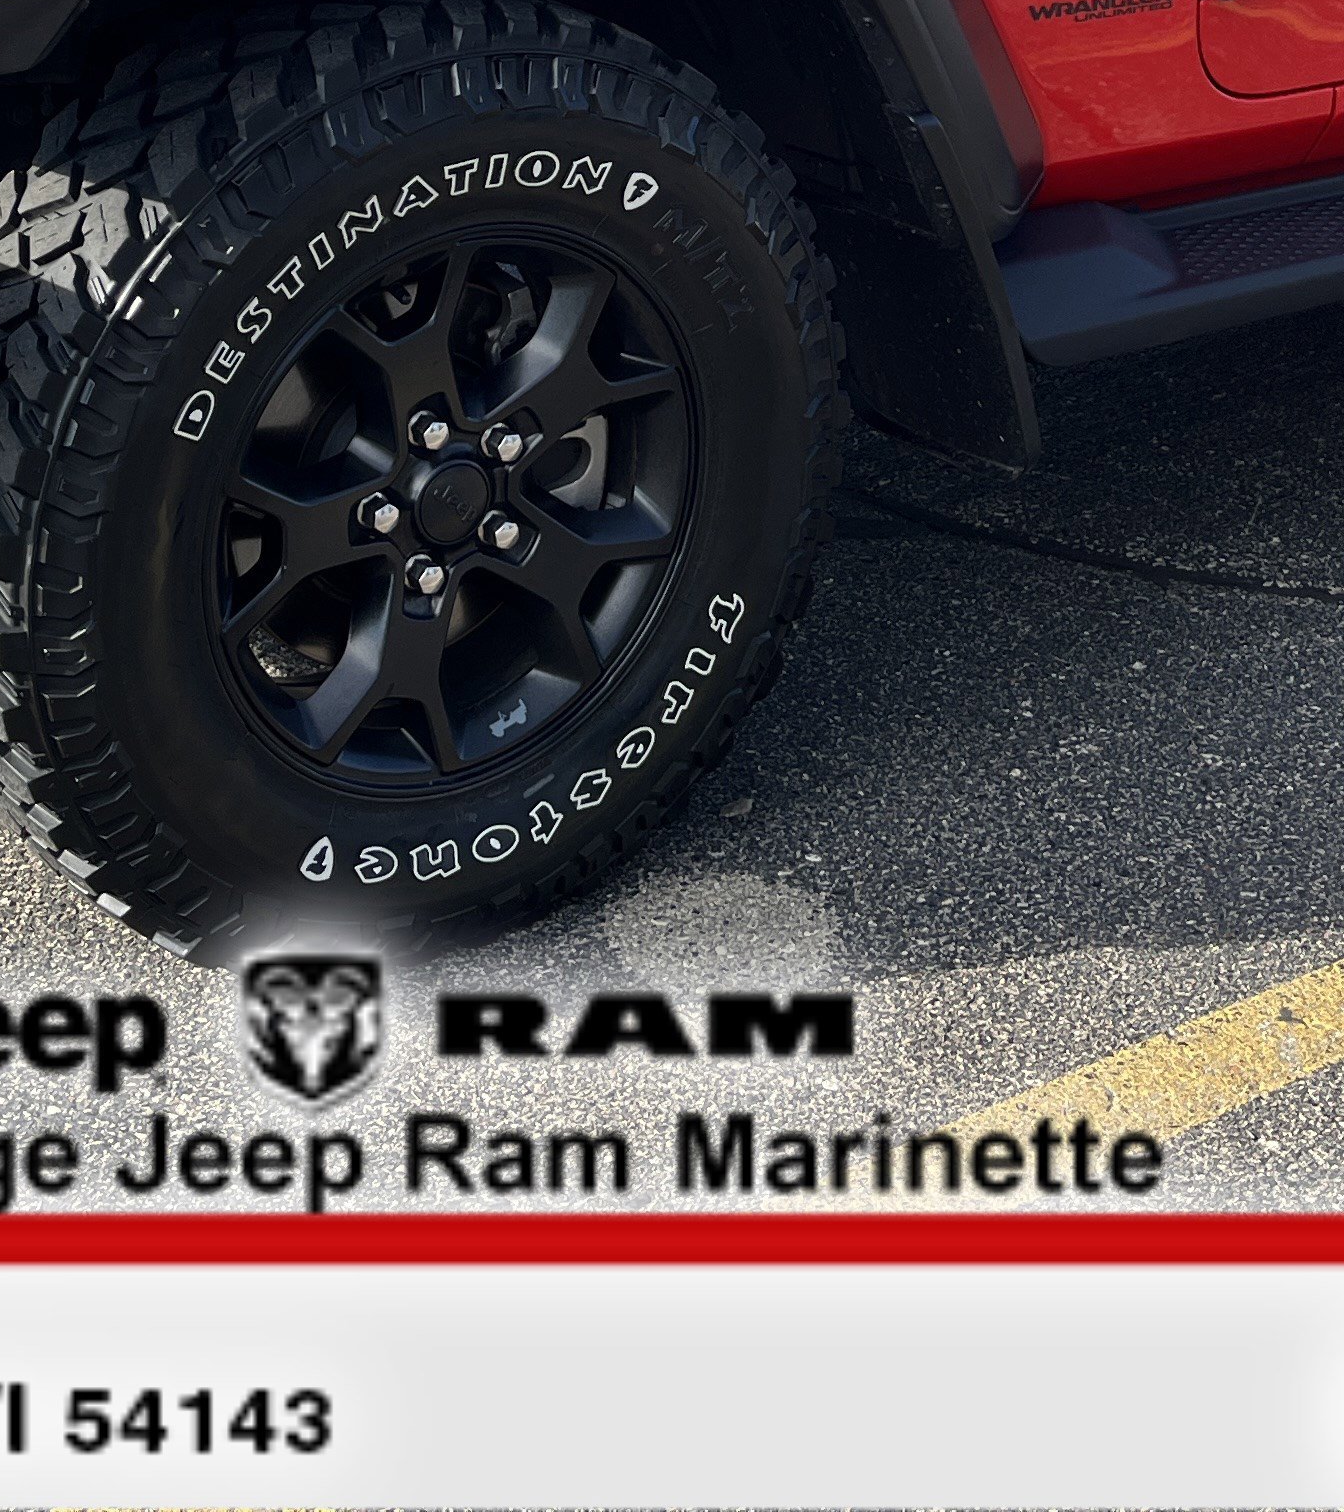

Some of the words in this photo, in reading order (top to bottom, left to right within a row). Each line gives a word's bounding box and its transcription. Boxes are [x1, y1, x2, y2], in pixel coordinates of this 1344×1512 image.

[1074, 1, 1172, 22] UNLIMITED
[172, 150, 613, 441] DESTINATION
[354, 593, 745, 884] Firestone
